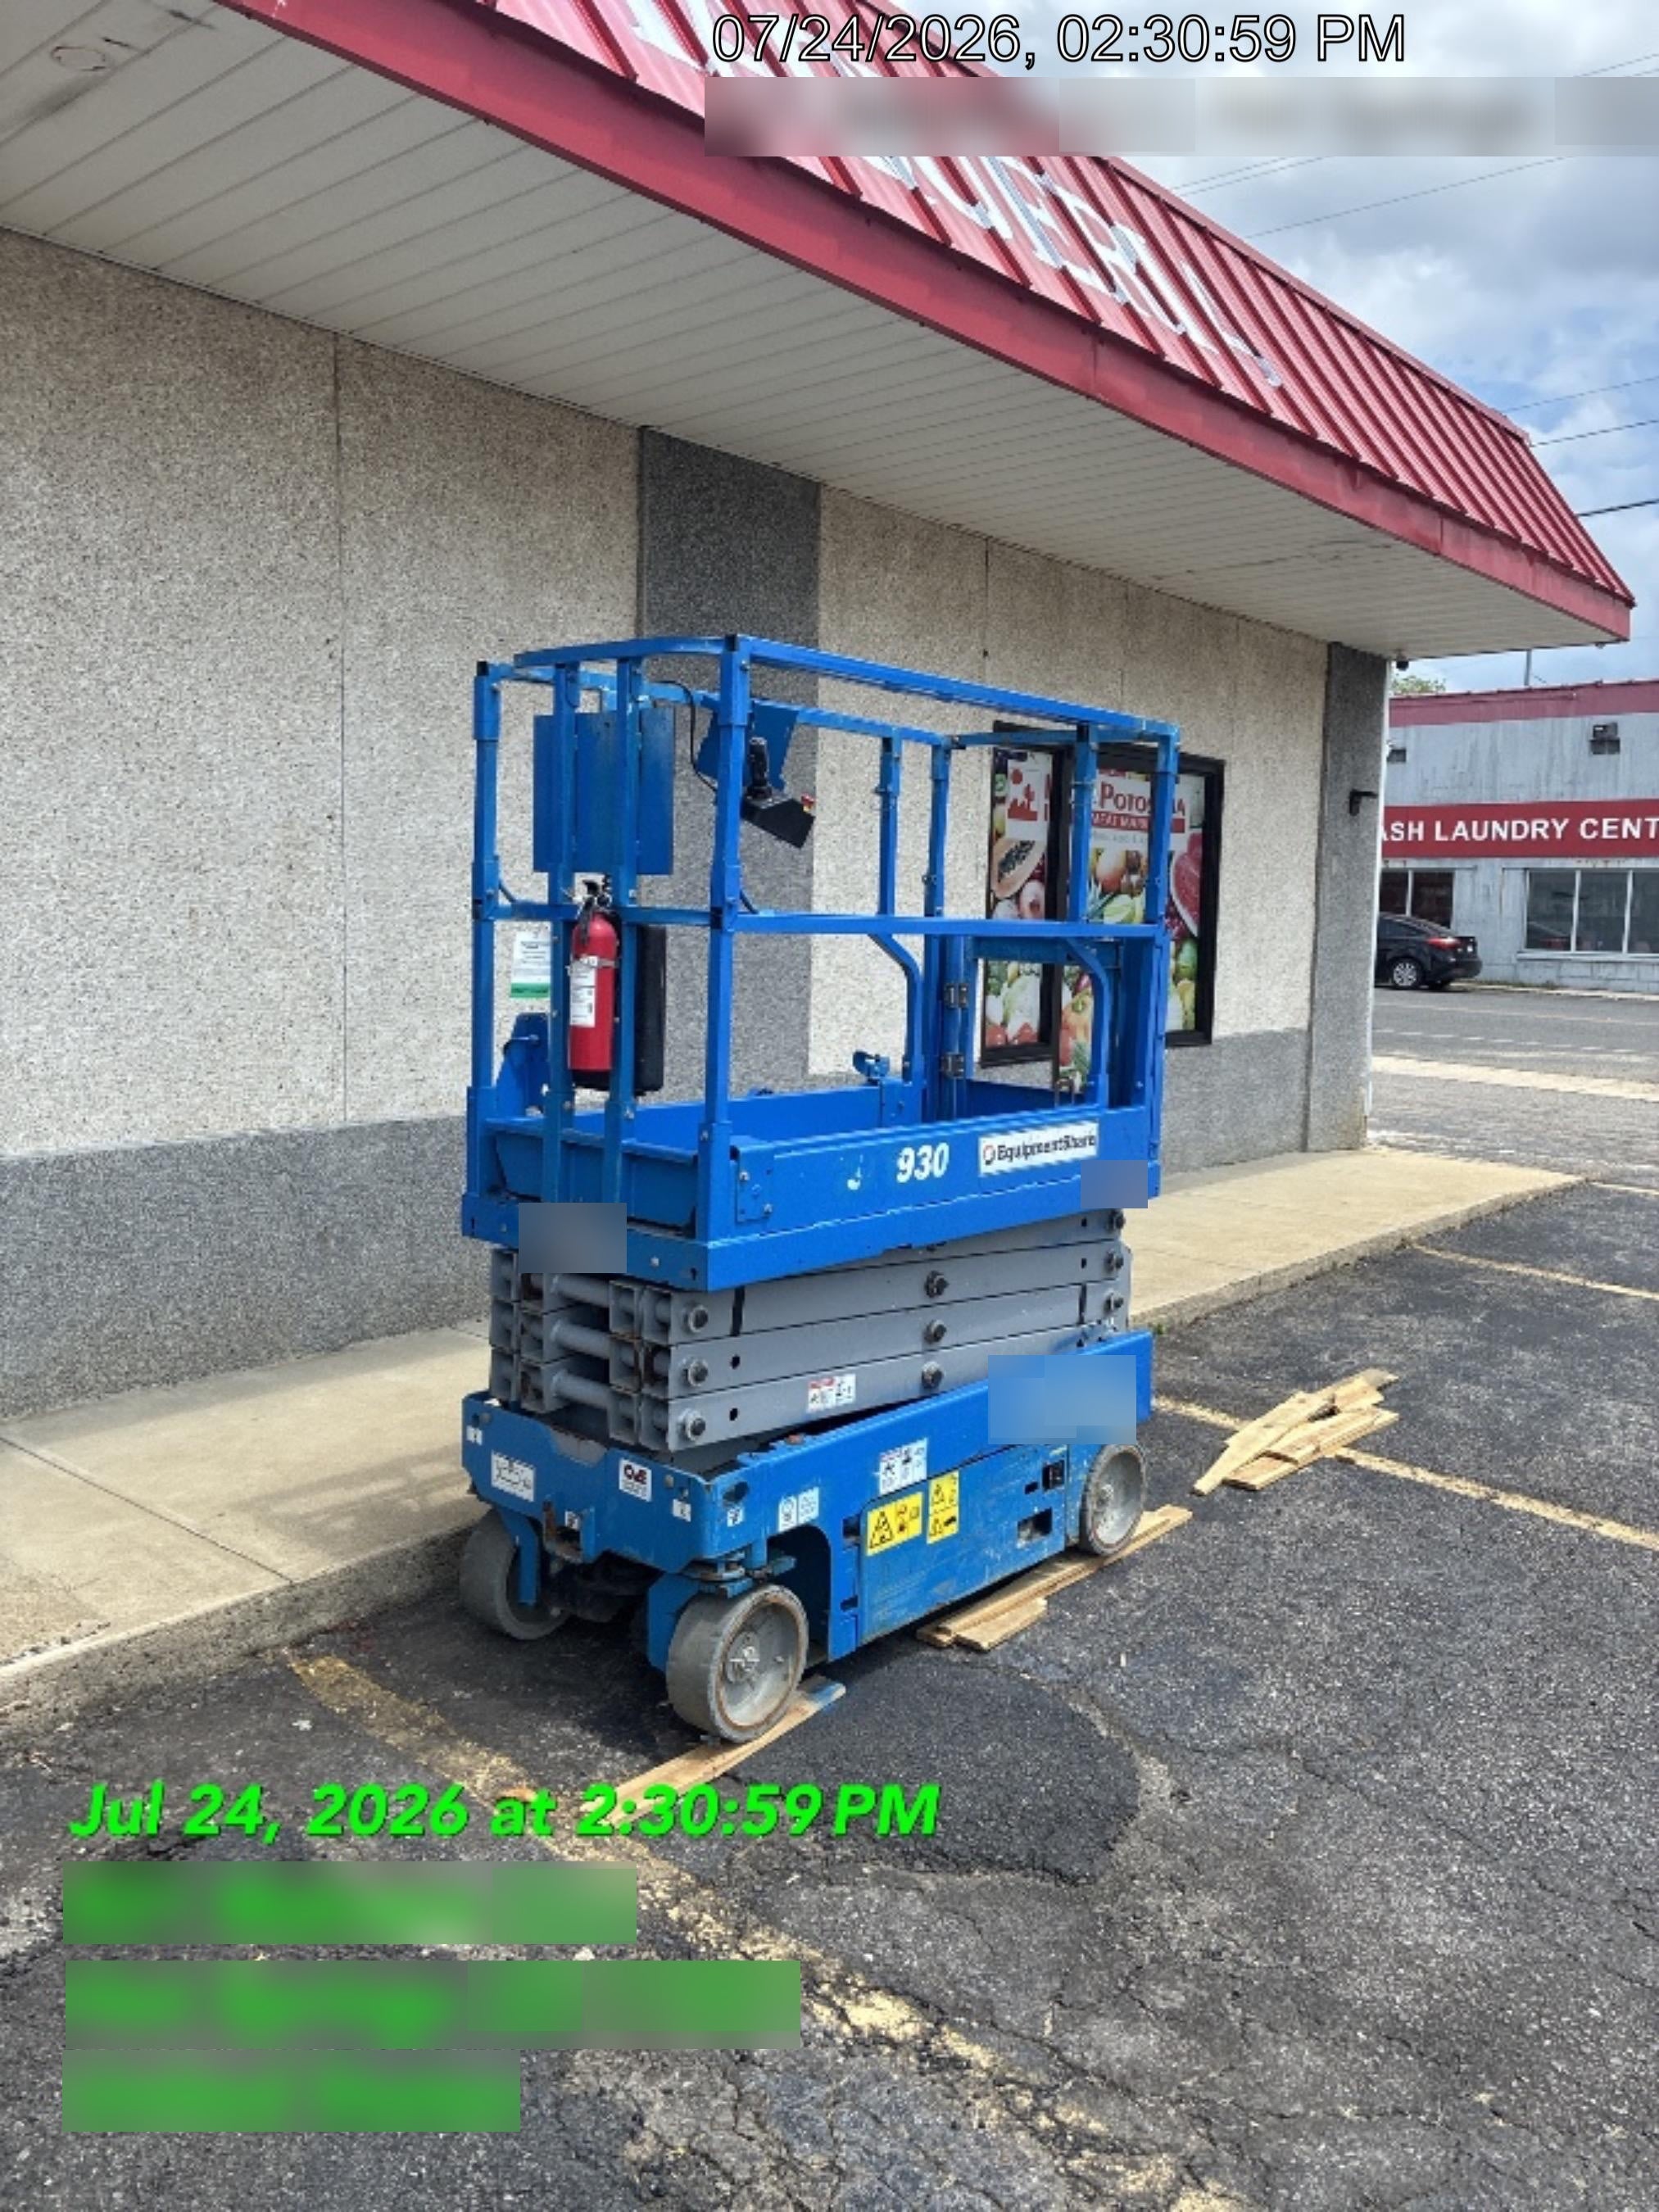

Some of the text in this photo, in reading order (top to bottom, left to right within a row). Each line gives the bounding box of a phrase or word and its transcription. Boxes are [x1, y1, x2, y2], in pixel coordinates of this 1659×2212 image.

[1435, 818, 1571, 841] LAUNDRY
[1580, 817, 1659, 840] CENT
[896, 1142, 950, 1184] 930
